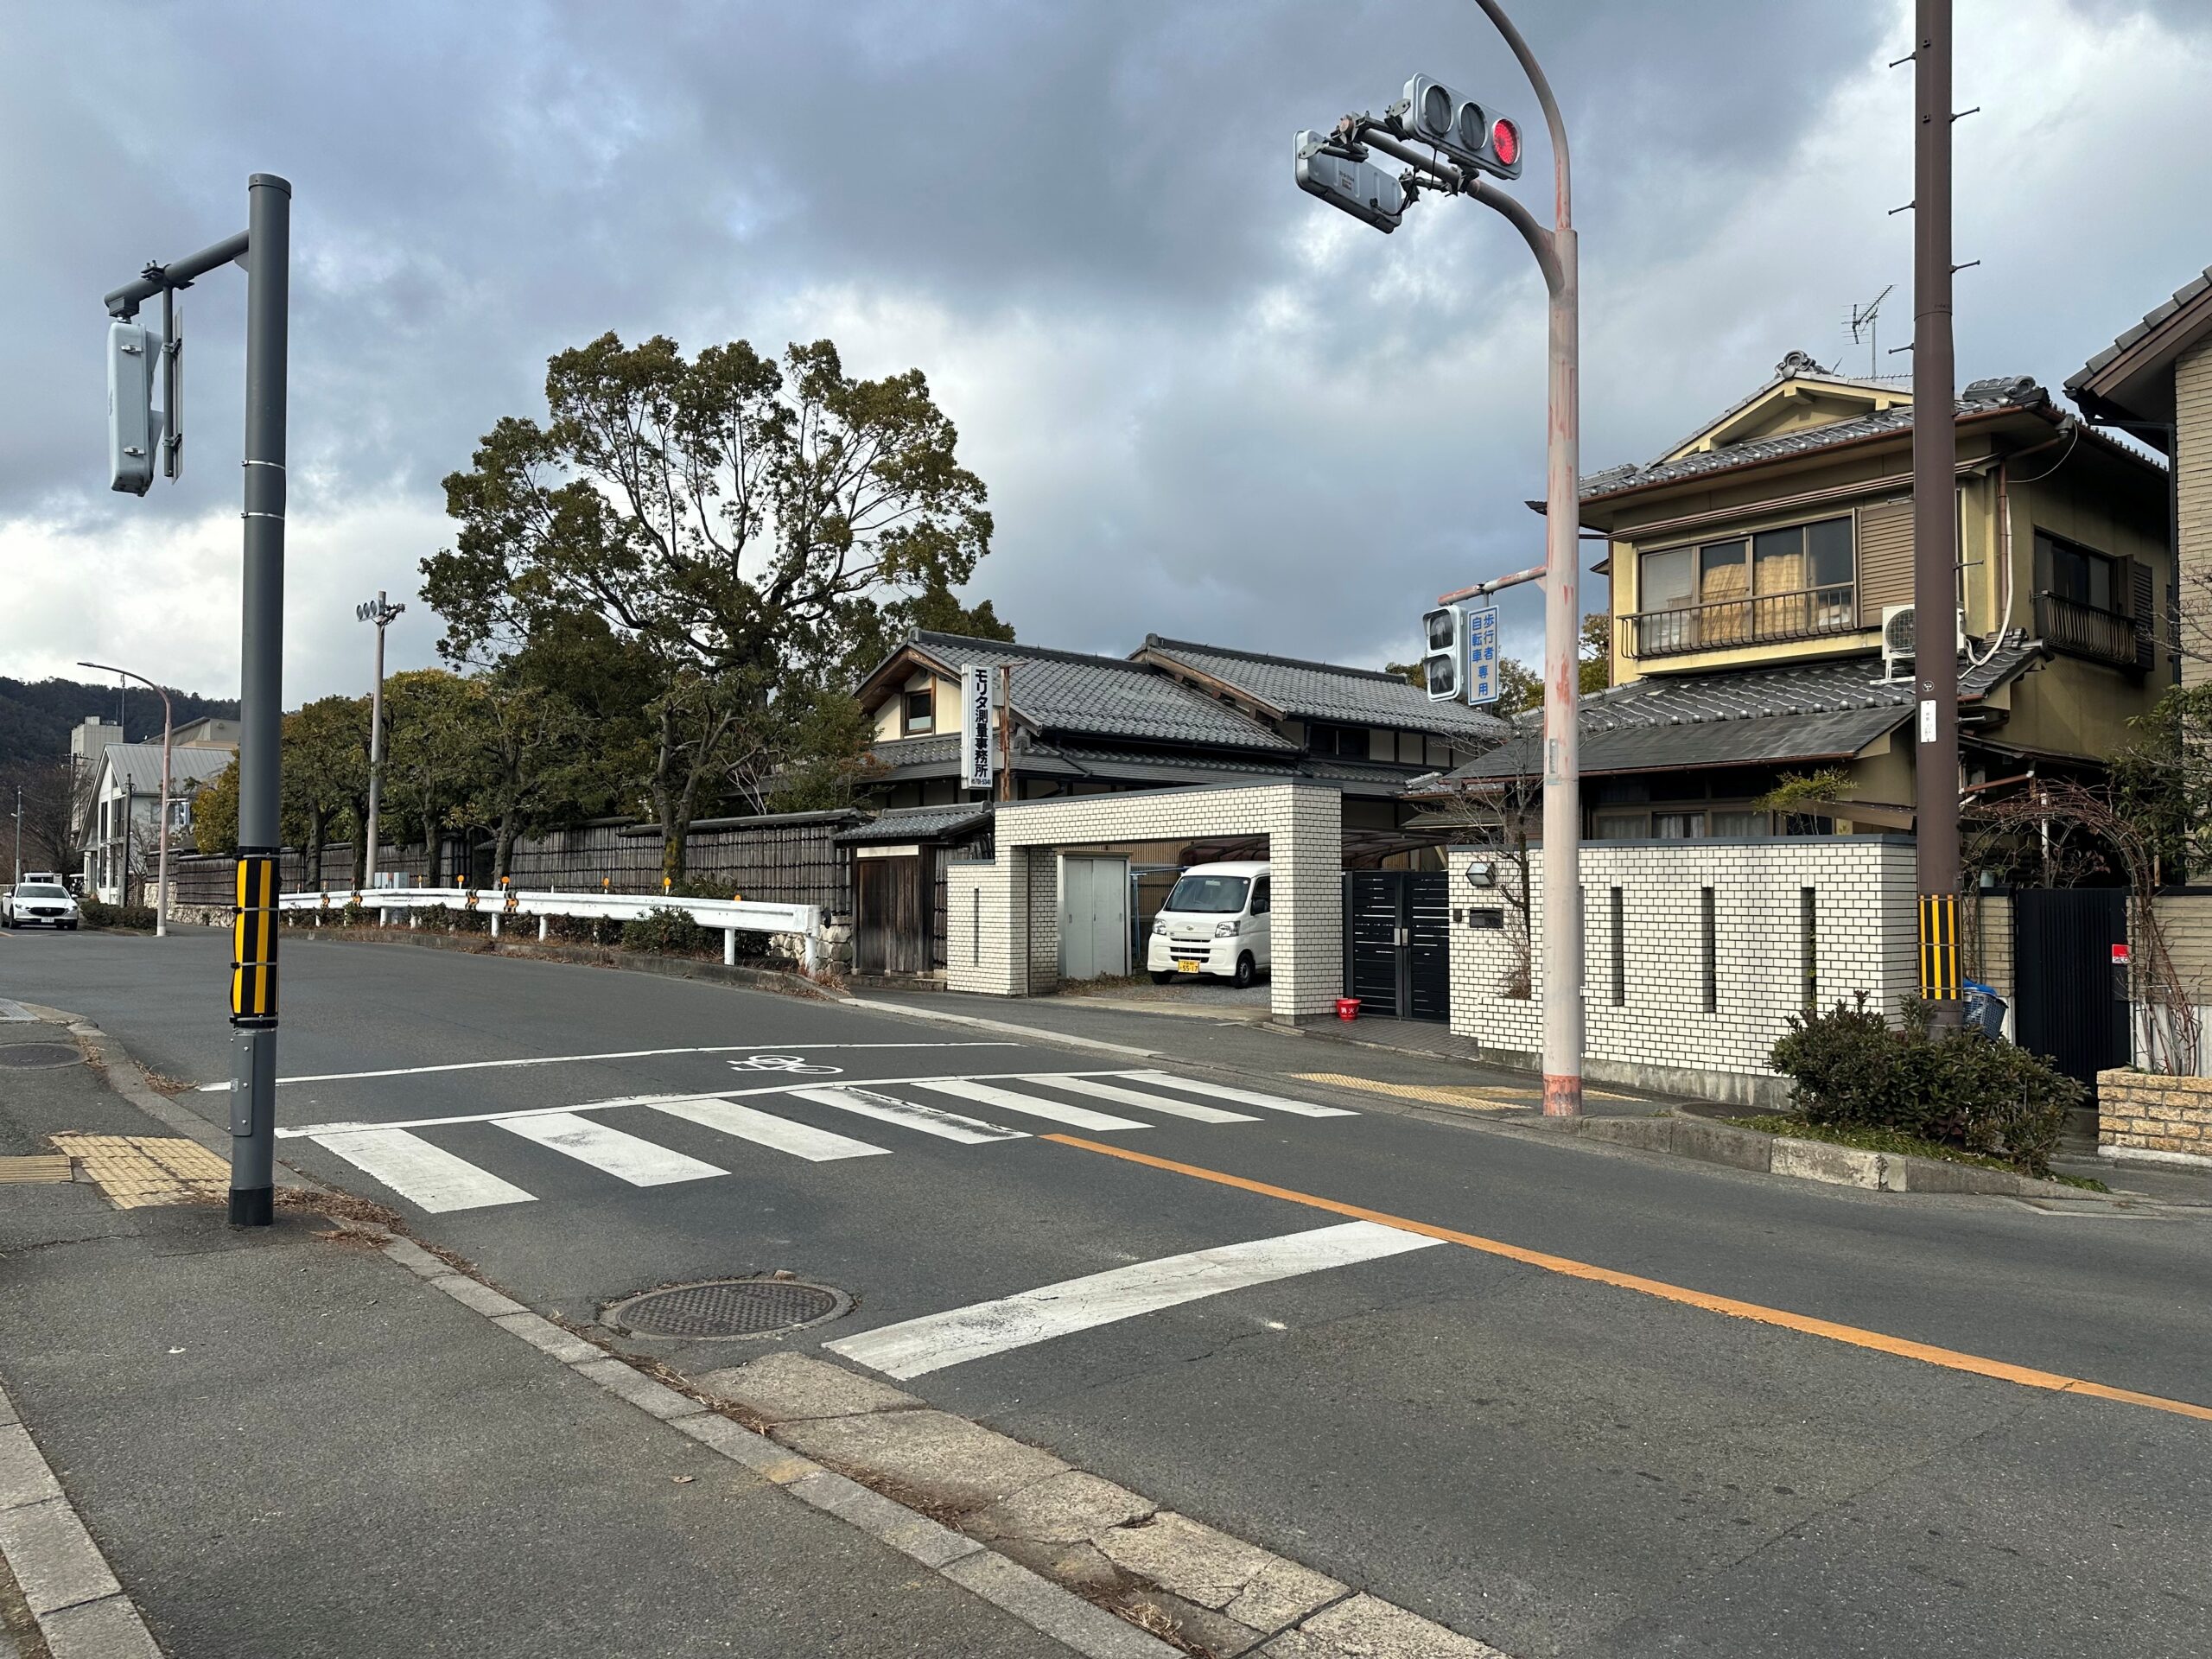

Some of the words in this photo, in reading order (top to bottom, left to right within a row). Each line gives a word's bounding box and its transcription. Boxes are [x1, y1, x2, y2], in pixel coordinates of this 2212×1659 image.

[1472, 617, 1482, 663] 自転車
[1484, 613, 1494, 660] 歩行者
[1478, 664, 1488, 697] 専用
[975, 669, 988, 778] モリタ測量事務所
